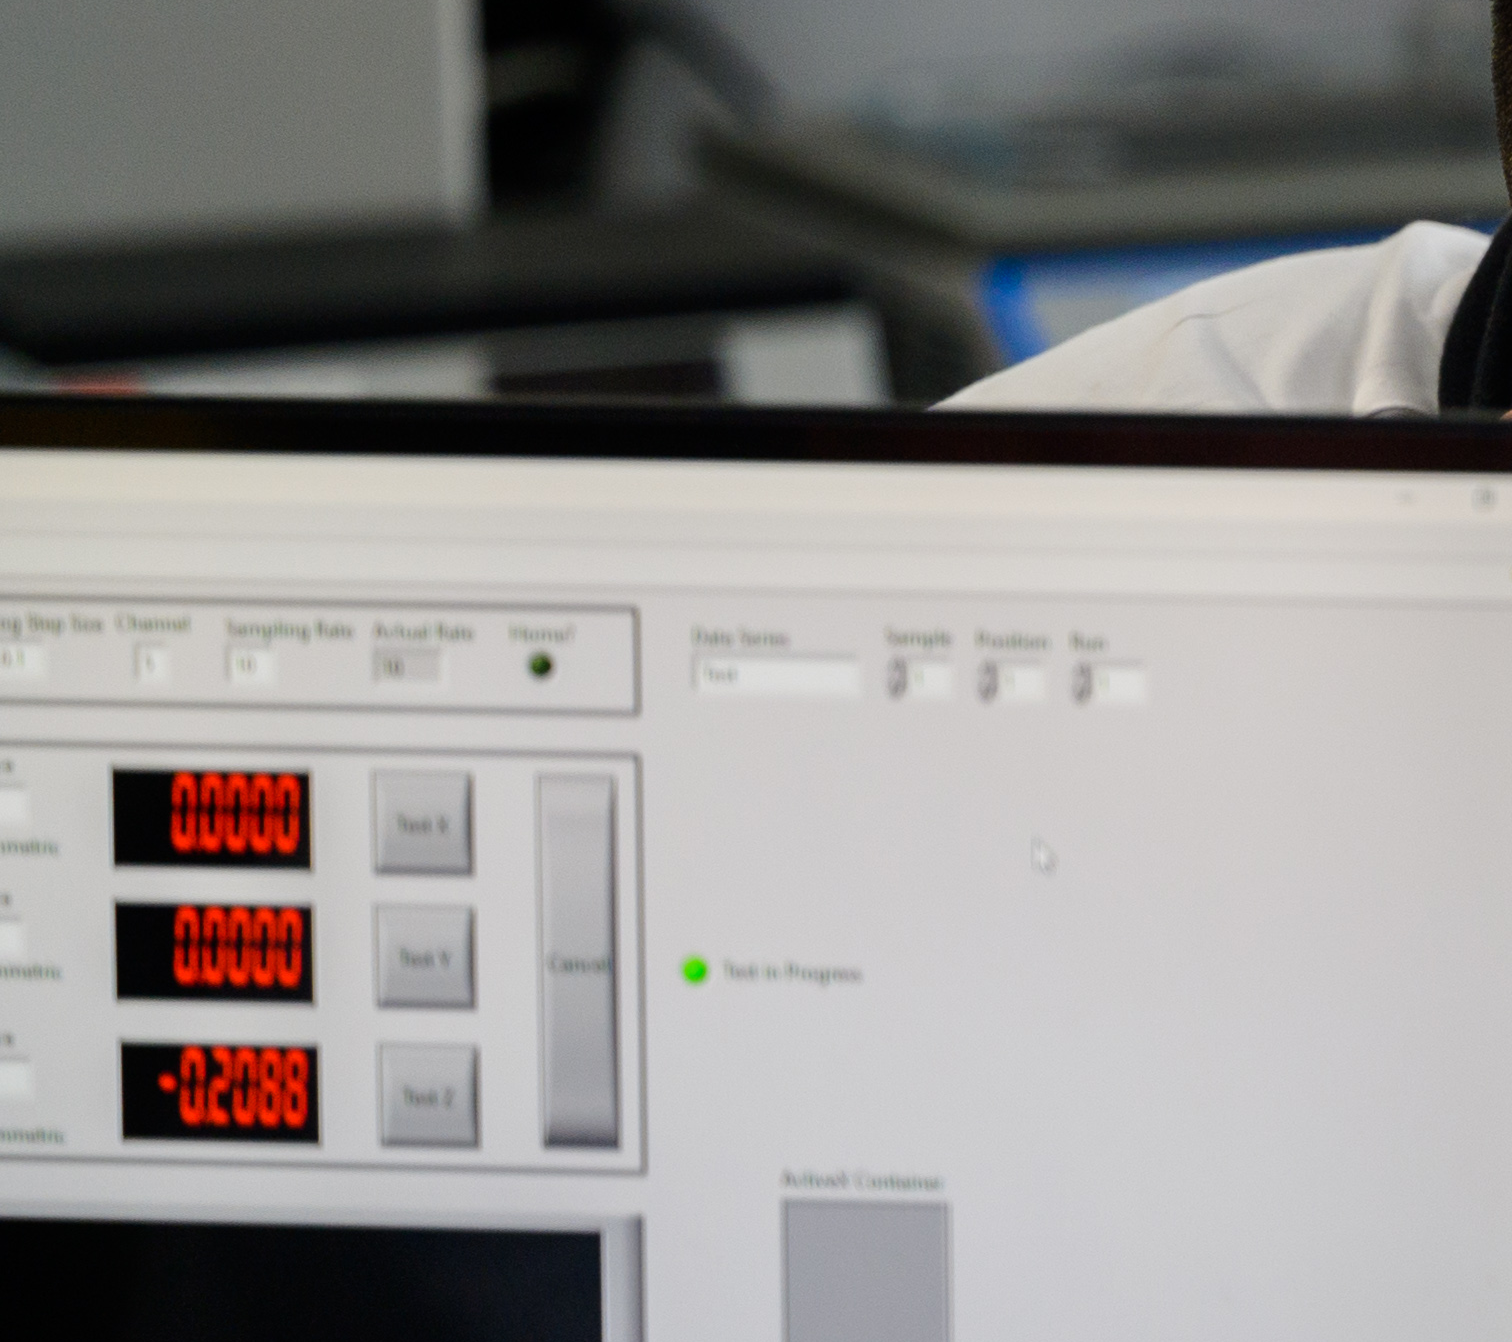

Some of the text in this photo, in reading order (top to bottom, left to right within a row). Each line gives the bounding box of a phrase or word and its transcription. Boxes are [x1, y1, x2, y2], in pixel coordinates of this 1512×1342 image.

[114, 613, 191, 633] Channel
[224, 617, 355, 643] Sampling Rate
[885, 625, 952, 650] Sample
[974, 627, 1051, 651] Position
[546, 952, 613, 974] Cancel
[784, 961, 863, 990] Progress
